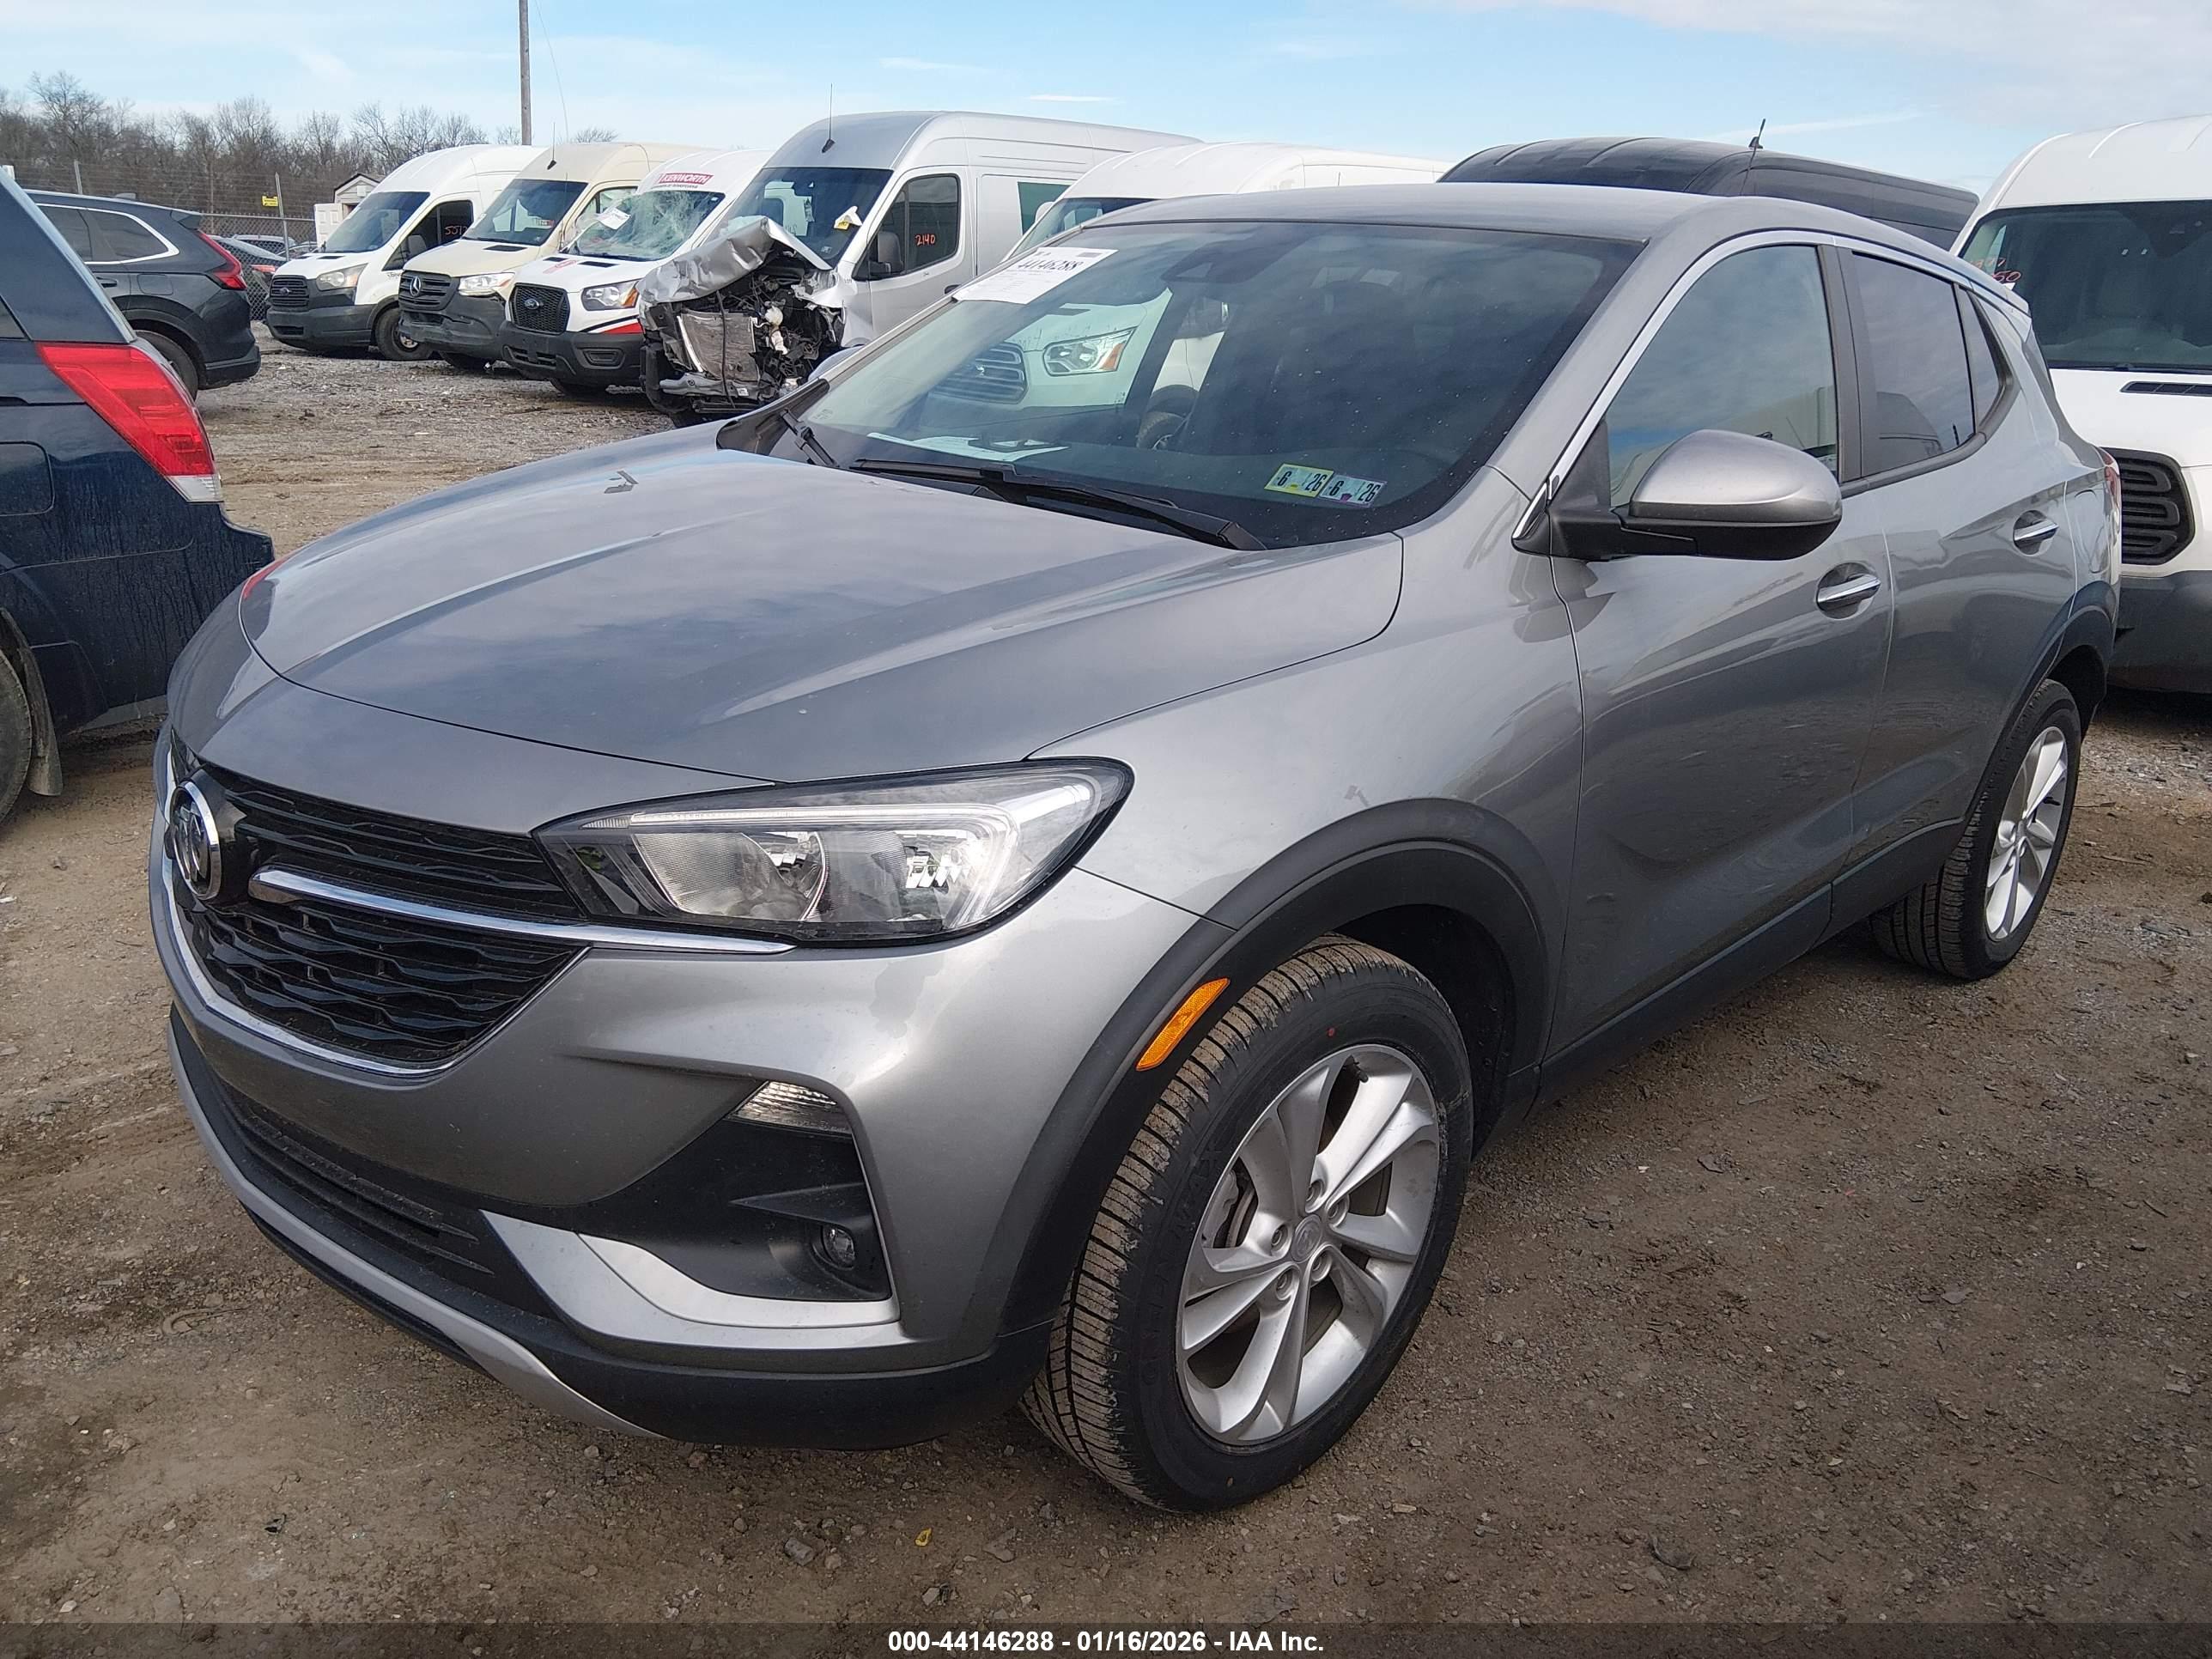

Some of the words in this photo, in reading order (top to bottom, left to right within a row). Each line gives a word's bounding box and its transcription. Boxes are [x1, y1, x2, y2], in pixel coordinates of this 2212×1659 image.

[915, 233, 935, 246] 2140
[1277, 471, 1292, 486] 6
[1304, 473, 1327, 492] 26
[1329, 480, 1345, 496] 6
[1358, 483, 1381, 502] 26
